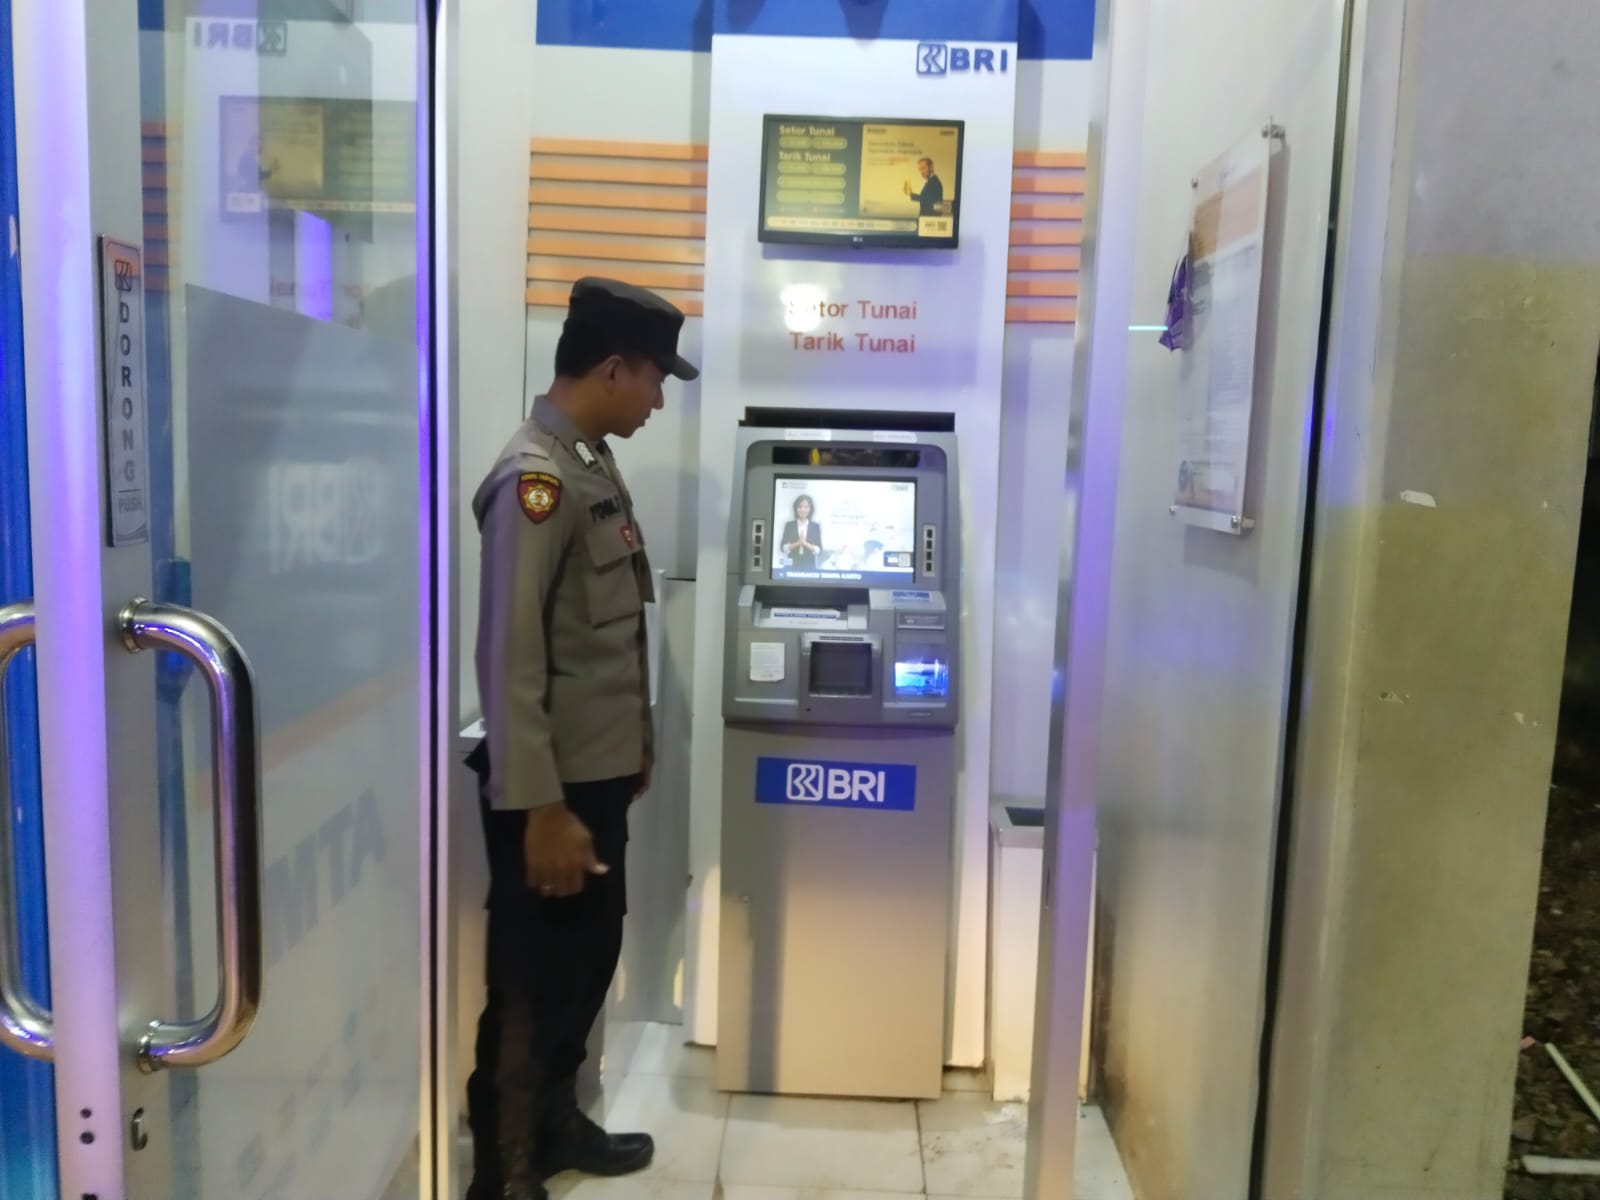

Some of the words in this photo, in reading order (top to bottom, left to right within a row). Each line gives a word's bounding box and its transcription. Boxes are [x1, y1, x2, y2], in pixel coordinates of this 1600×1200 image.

[950, 48, 1007, 72] BRI
[789, 300, 848, 318] tor
[857, 300, 917, 319] Tunai
[789, 331, 845, 351] Tarik
[855, 333, 915, 353] Tunai
[118, 301, 136, 483] DORONG
[827, 768, 886, 803] BRI
